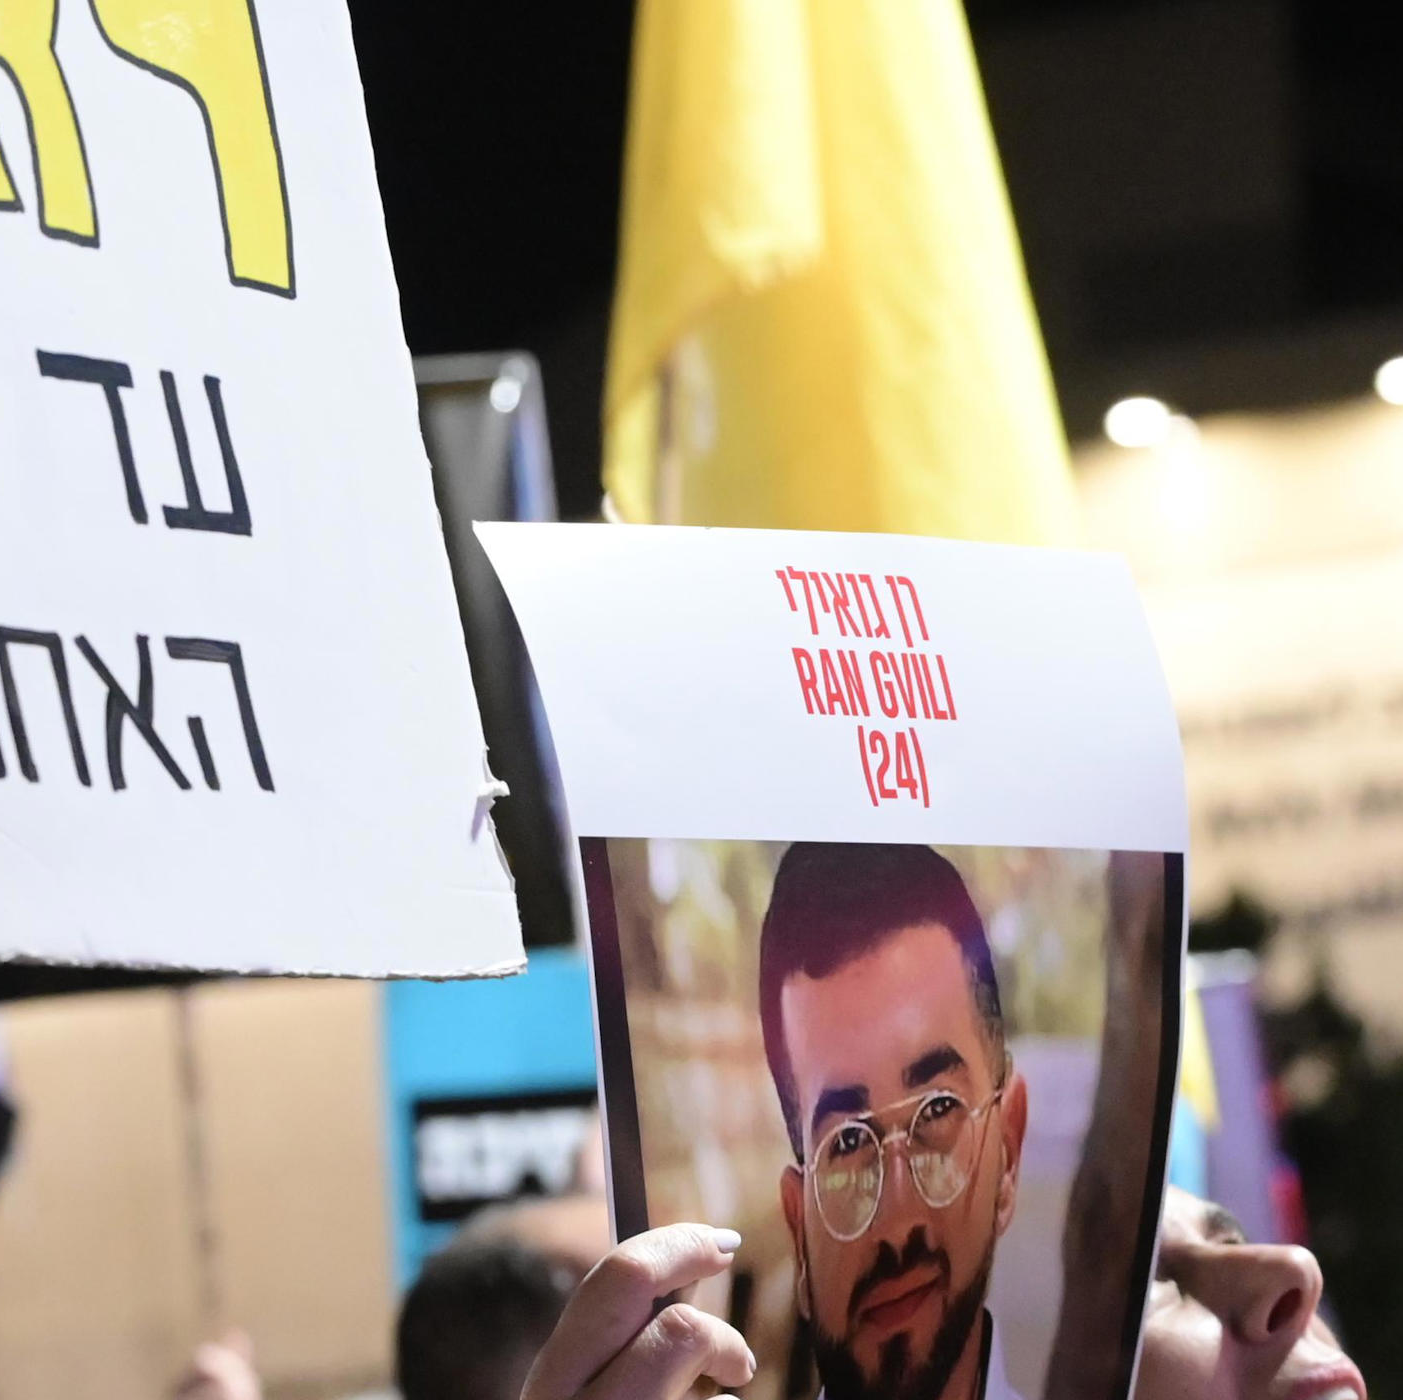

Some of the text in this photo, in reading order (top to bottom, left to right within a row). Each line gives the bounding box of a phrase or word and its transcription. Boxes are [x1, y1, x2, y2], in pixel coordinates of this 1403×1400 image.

[36, 349, 253, 537] עד
[774, 565, 930, 649] רן גואילי
[791, 647, 958, 721] RAN GVILI
[856, 725, 931, 809] (24)
